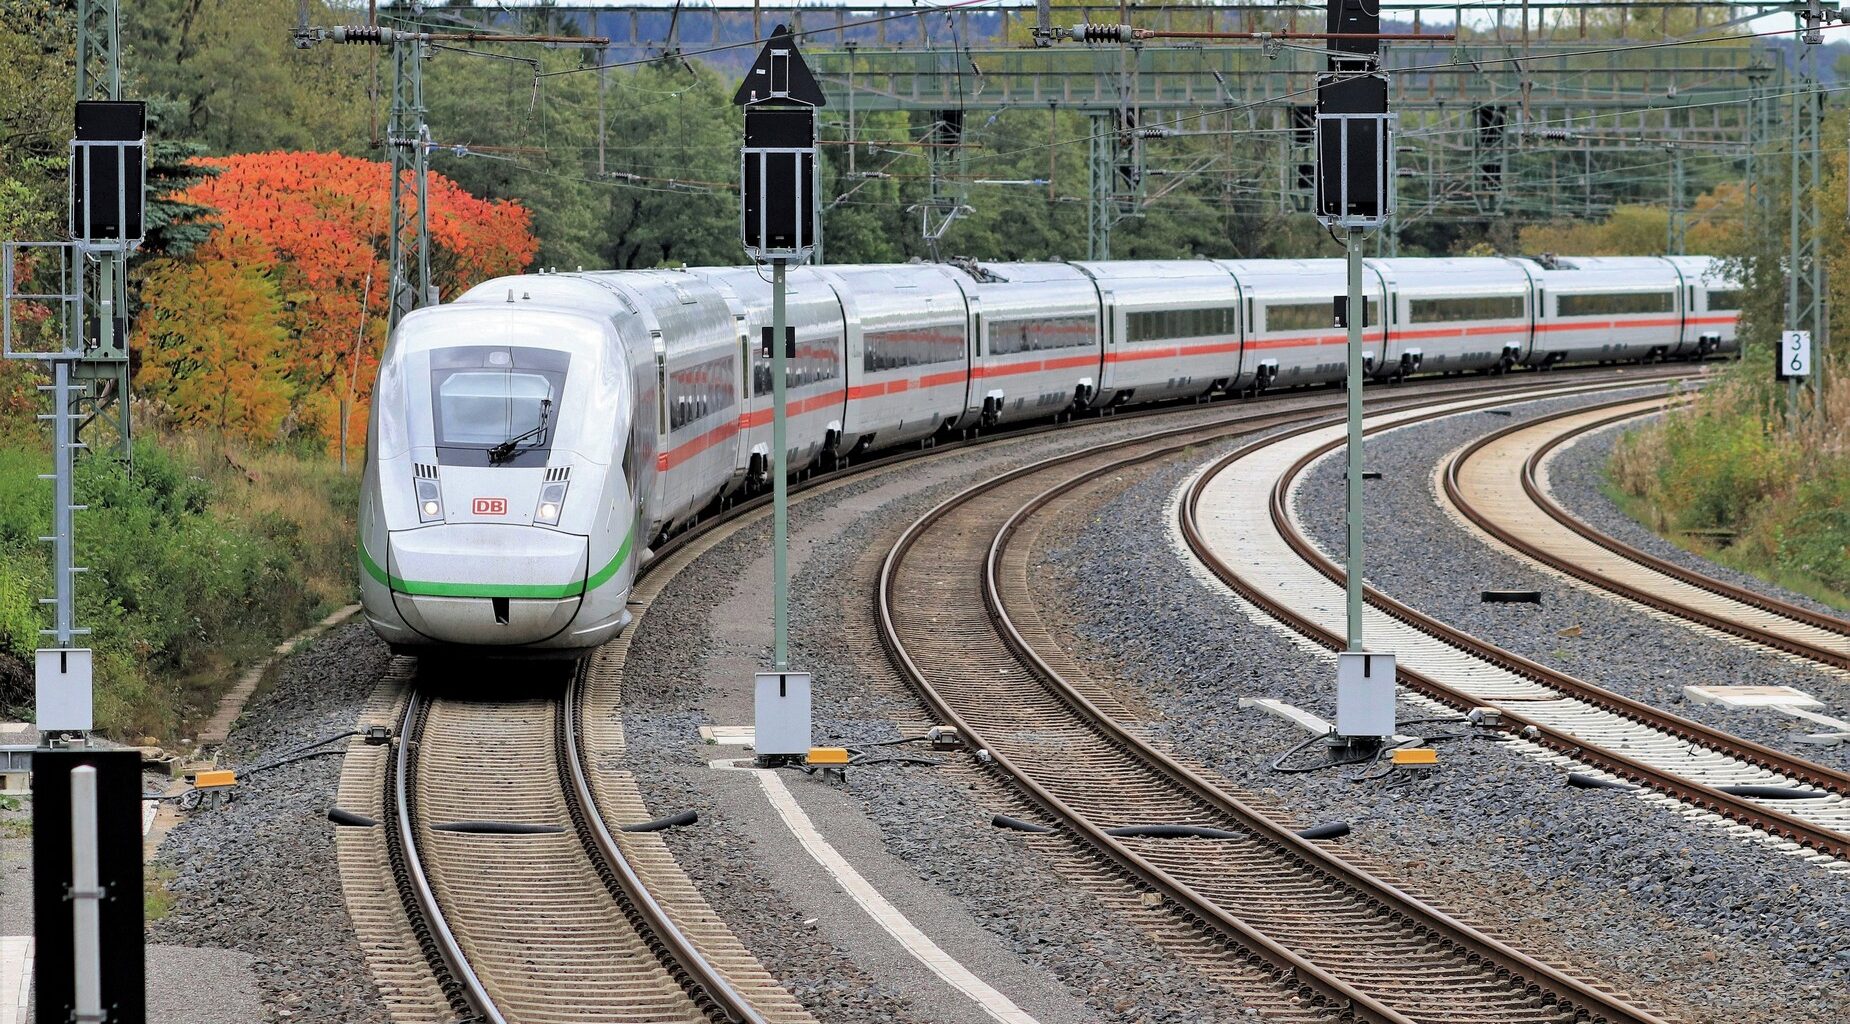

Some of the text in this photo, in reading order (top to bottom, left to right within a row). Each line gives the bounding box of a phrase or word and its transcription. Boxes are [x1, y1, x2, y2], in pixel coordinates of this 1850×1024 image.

[1791, 333, 1801, 351] 3
[1790, 353, 1802, 371] 6
[476, 500, 504, 513] DB
